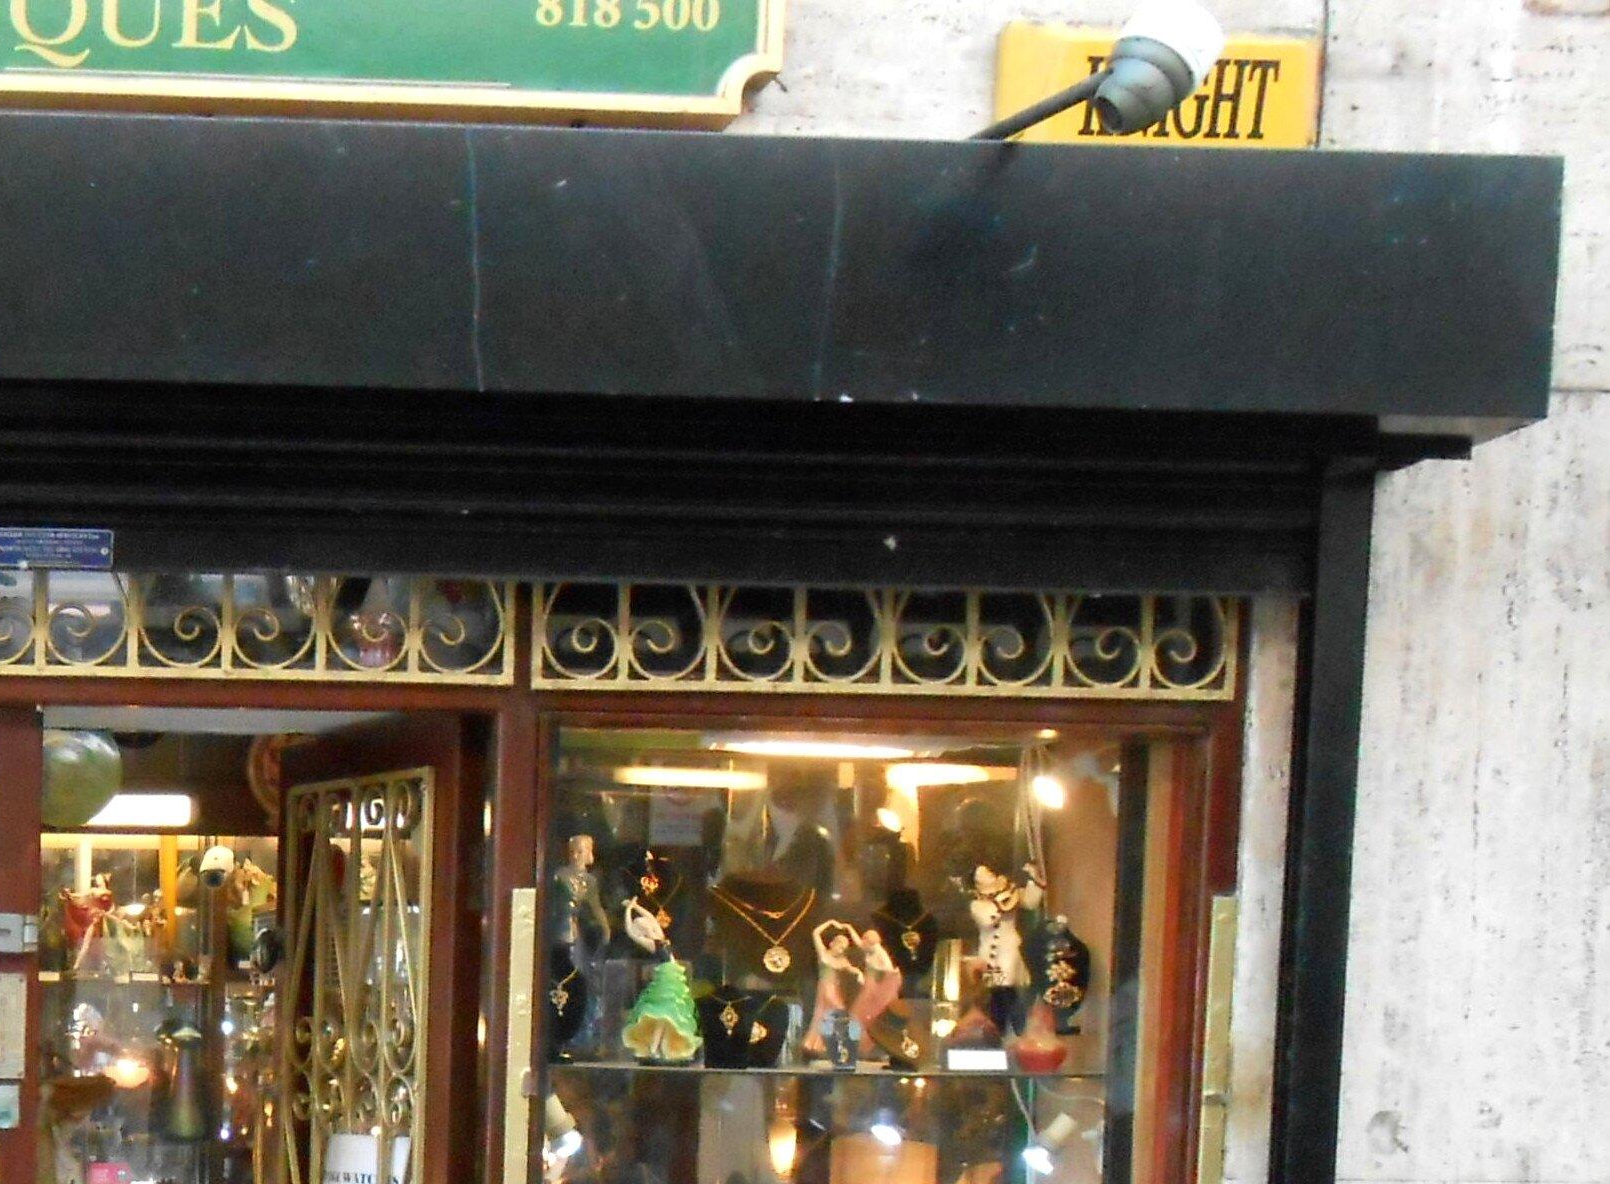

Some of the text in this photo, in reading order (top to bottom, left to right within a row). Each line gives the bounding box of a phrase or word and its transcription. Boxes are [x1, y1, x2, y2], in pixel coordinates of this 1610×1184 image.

[535, 0, 720, 31] 818 500
[1077, 55, 1280, 140] KGHT
